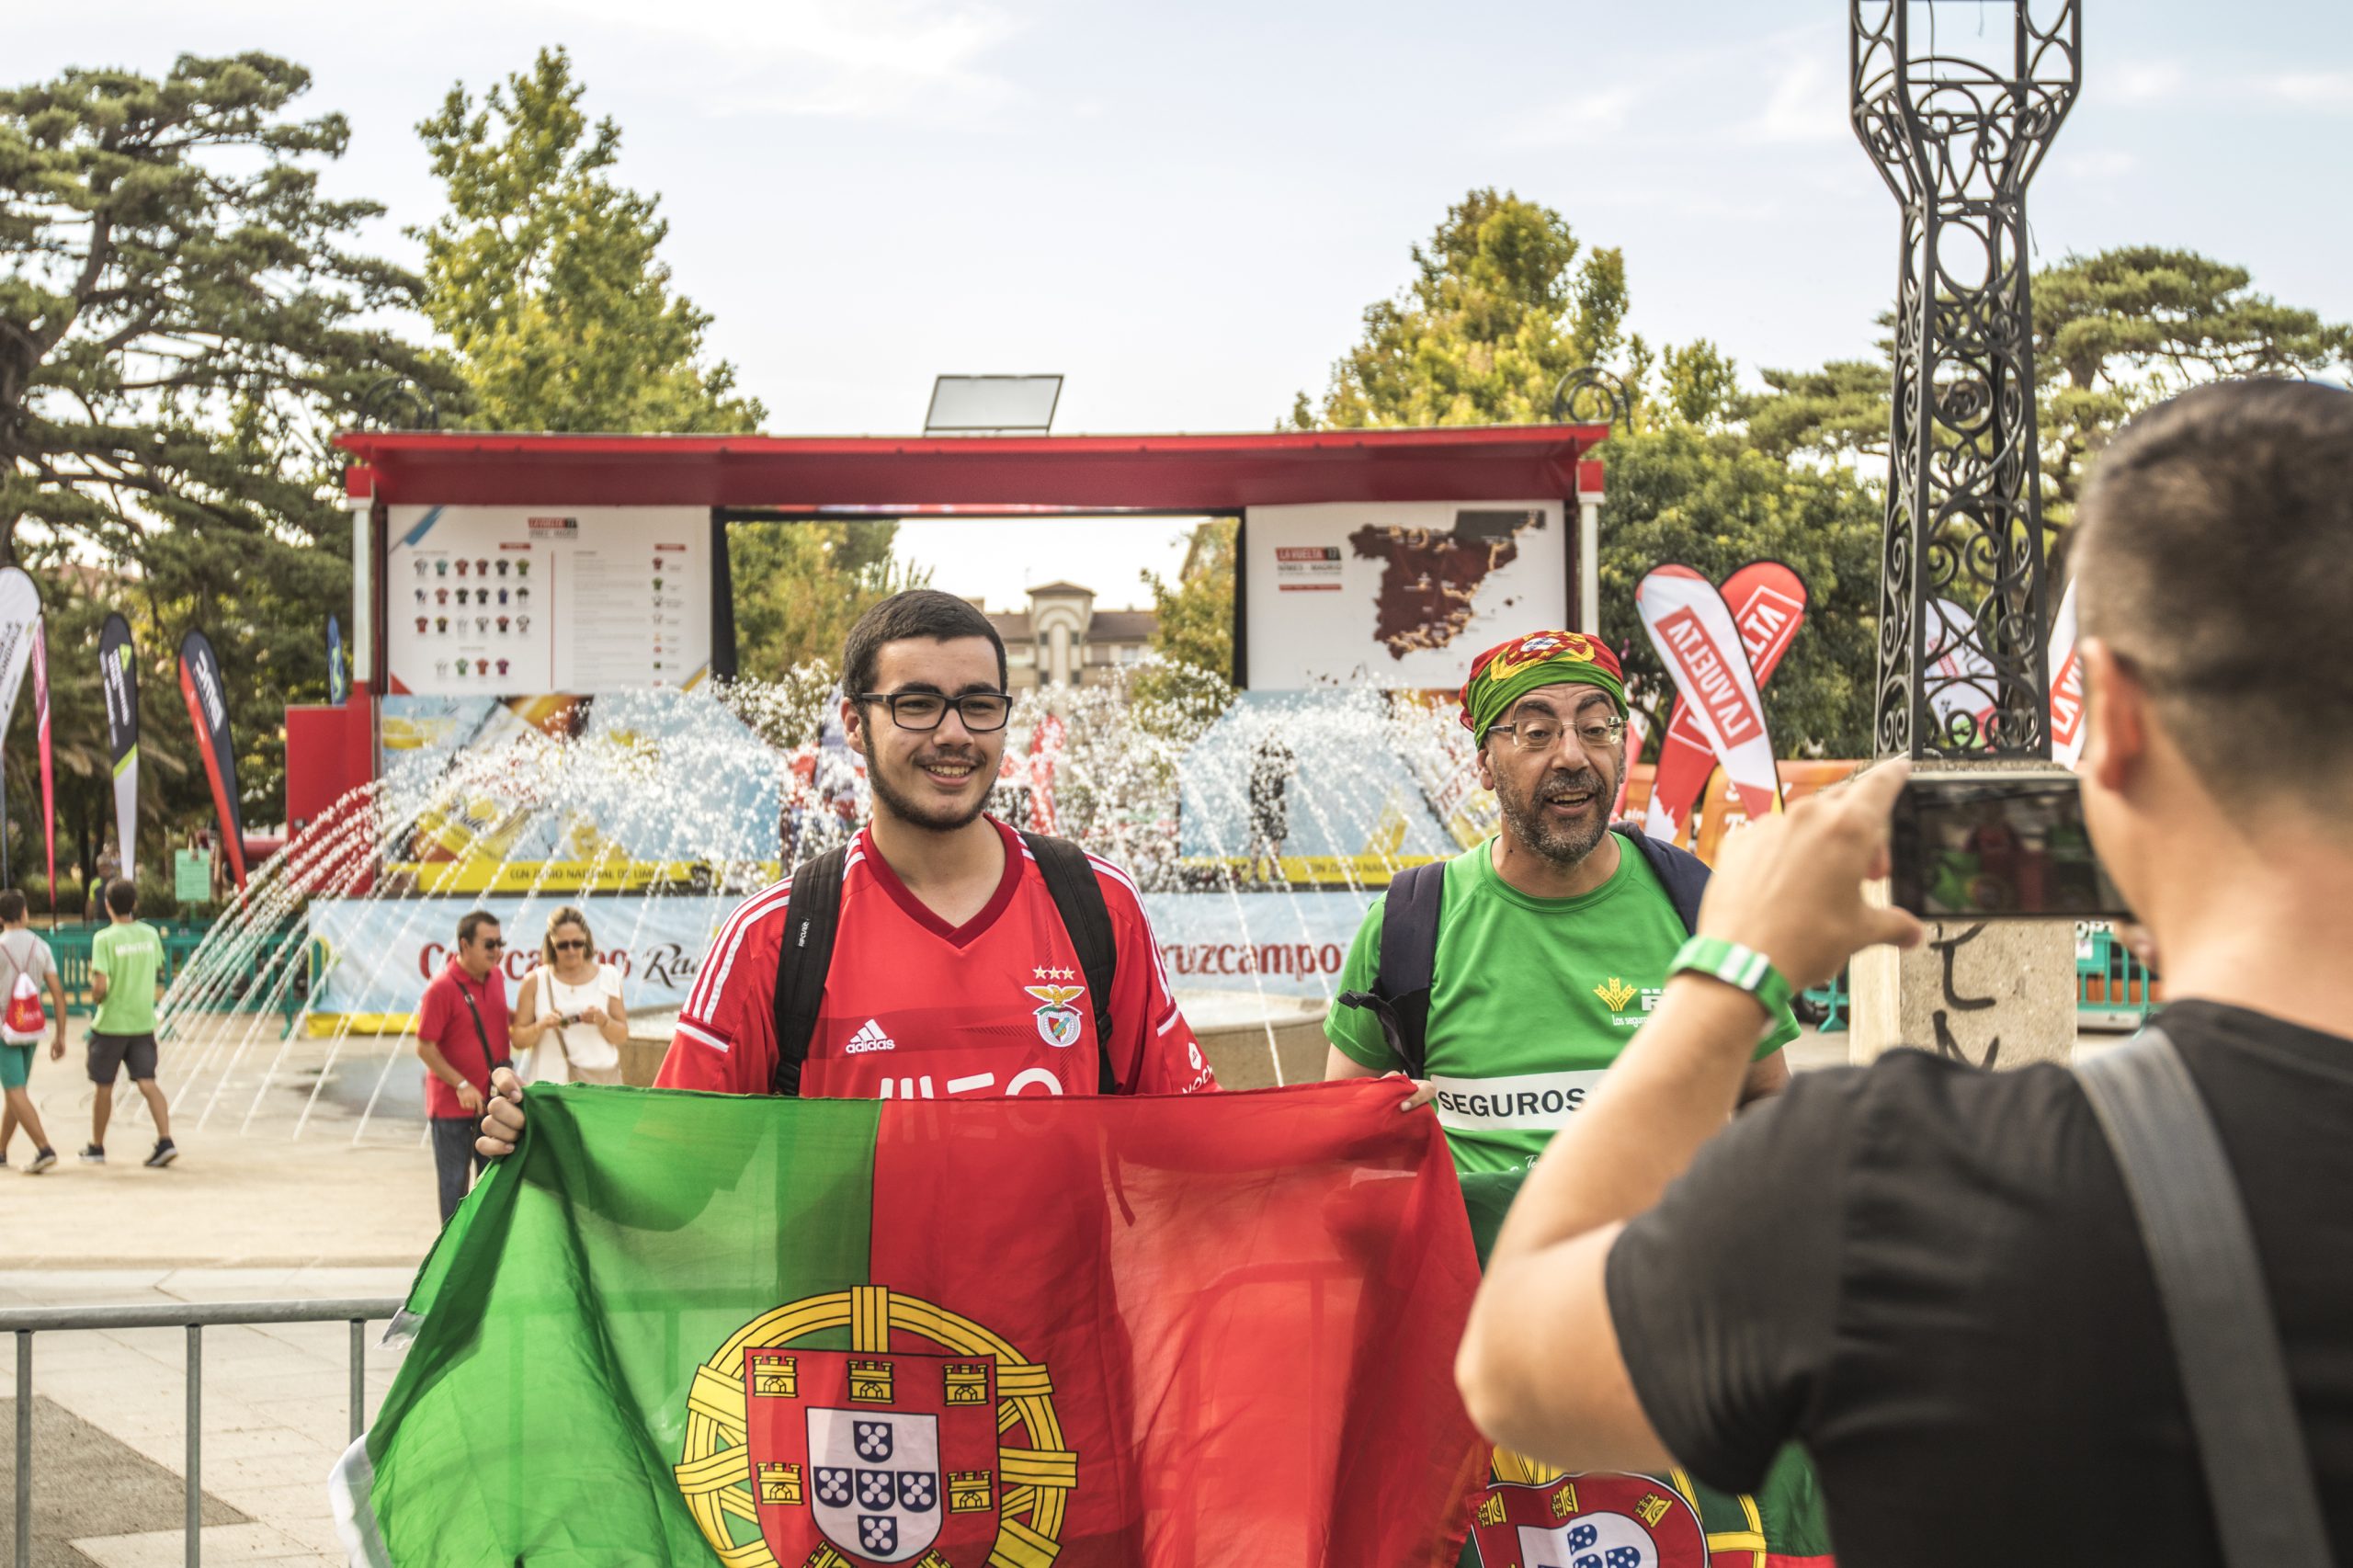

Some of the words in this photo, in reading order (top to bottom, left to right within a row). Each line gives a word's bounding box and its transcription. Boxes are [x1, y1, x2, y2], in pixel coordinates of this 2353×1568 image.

[1160, 941, 1342, 981] ruzcampo
[845, 1038, 896, 1054] adidas
[1438, 1087, 1586, 1118] SEGUROS
